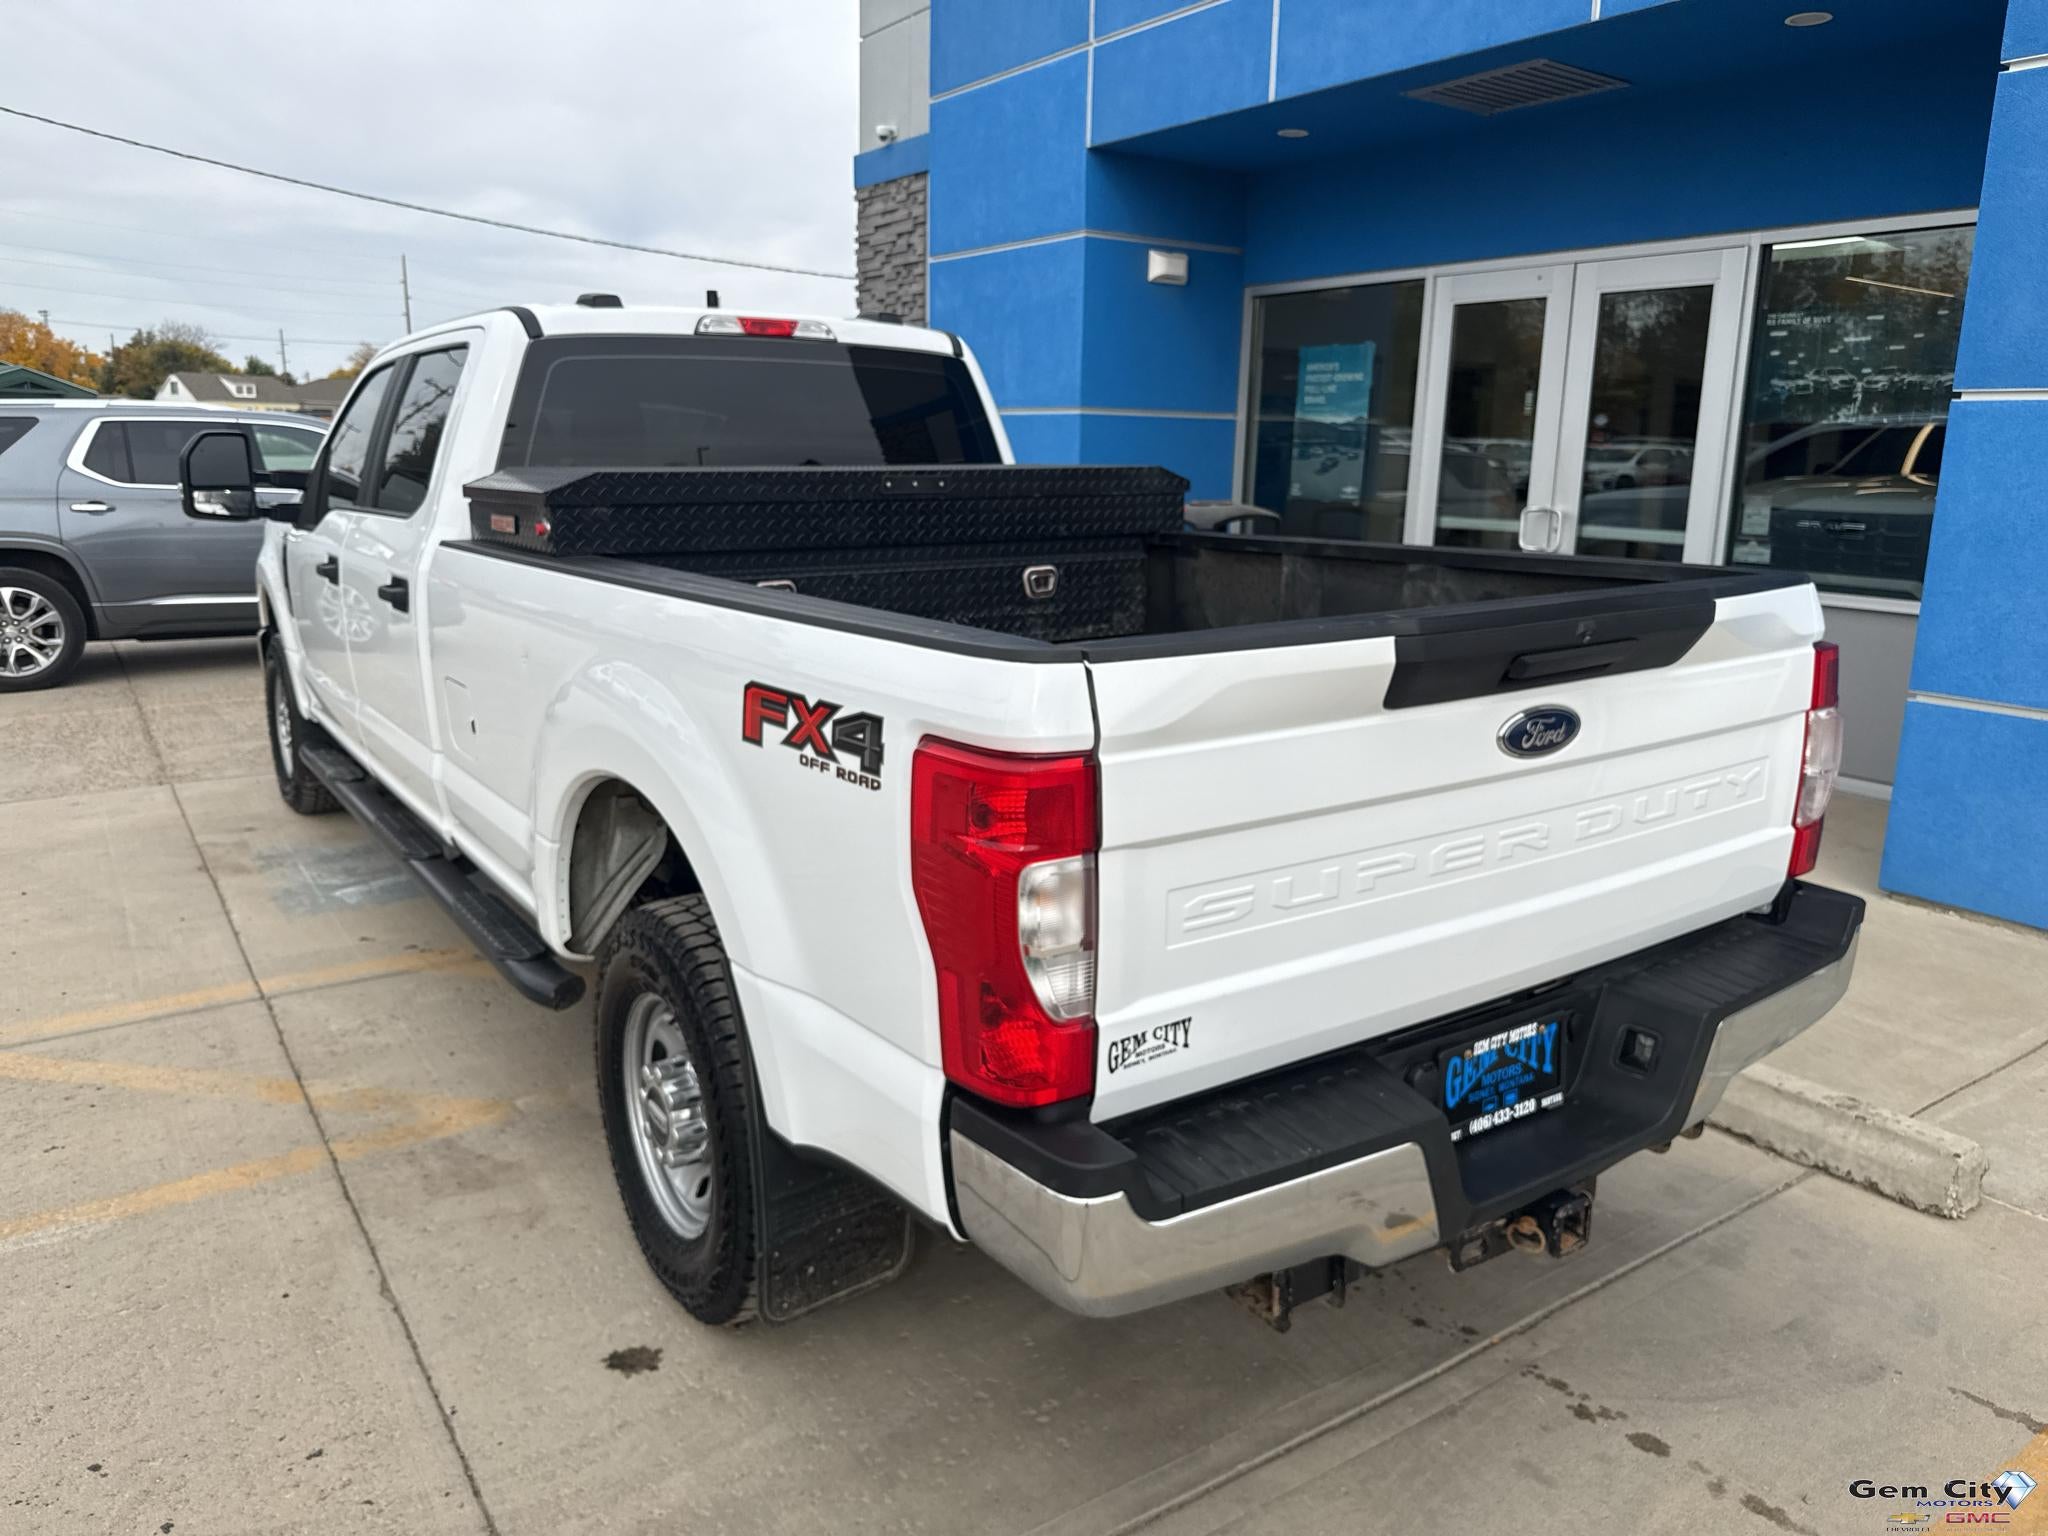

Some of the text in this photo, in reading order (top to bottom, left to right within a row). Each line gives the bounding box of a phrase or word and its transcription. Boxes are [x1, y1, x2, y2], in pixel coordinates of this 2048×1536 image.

[742, 680, 885, 778] FX4
[1521, 716, 1566, 749] Ford
[800, 753, 881, 791] OFF ROAD
[1183, 765, 1761, 932] SUPER DUTY
[1108, 1016, 1192, 1074] GEM CITY
[1473, 1022, 1538, 1056] GEM CITY MOTORS
[1481, 1062, 1524, 1086] MOTORS
